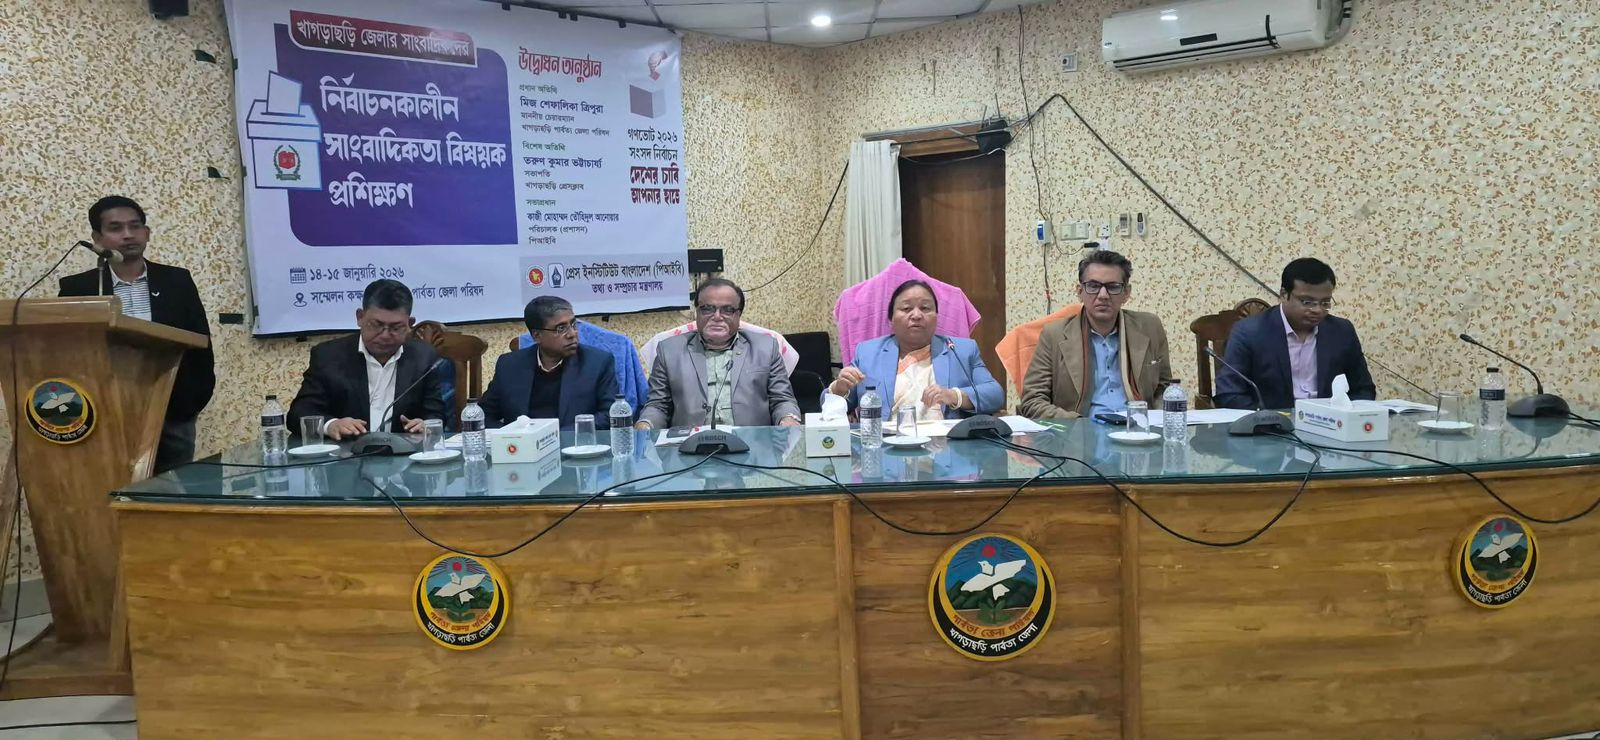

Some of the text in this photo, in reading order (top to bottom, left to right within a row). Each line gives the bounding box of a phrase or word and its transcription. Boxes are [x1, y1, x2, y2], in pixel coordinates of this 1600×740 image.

[297, 20, 356, 48] খাগড়াছড়ি
[361, 28, 398, 49] জেলার
[519, 46, 602, 83] উদ্বোধন অনুষ্ঠান
[319, 73, 460, 122] নির্বাচনকালীন
[520, 95, 604, 115] মিজ শেফালিকা ত্রিপুরা
[628, 125, 678, 143] গণভোট ২০২৬
[323, 127, 507, 169] সাংবাদিকতা বিষয়ক
[629, 144, 678, 160] সংসদ নির্বাচন
[523, 156, 546, 167] তরুণ
[548, 157, 570, 168] কুমার
[630, 162, 680, 185] দেশের চাবি
[328, 171, 414, 208] প্রশিক্ষণ
[630, 188, 680, 205] আপনার হাতে
[526, 210, 542, 221] কাজী
[310, 263, 405, 282] ১৪-১৫ জানুয়ারি ২০২৬
[566, 260, 685, 280] প্রেস ইনস্টিটিউট বাংলাদেশ (পিআইবি)
[311, 290, 344, 305] সম্মেলন
[412, 283, 436, 299] পার্বত্য
[438, 286, 458, 298] জেলা
[461, 282, 485, 297] পরিষদ
[592, 283, 605, 294] তথ্য
[607, 285, 613, 293] ও
[615, 281, 637, 294] সম্প্রচার
